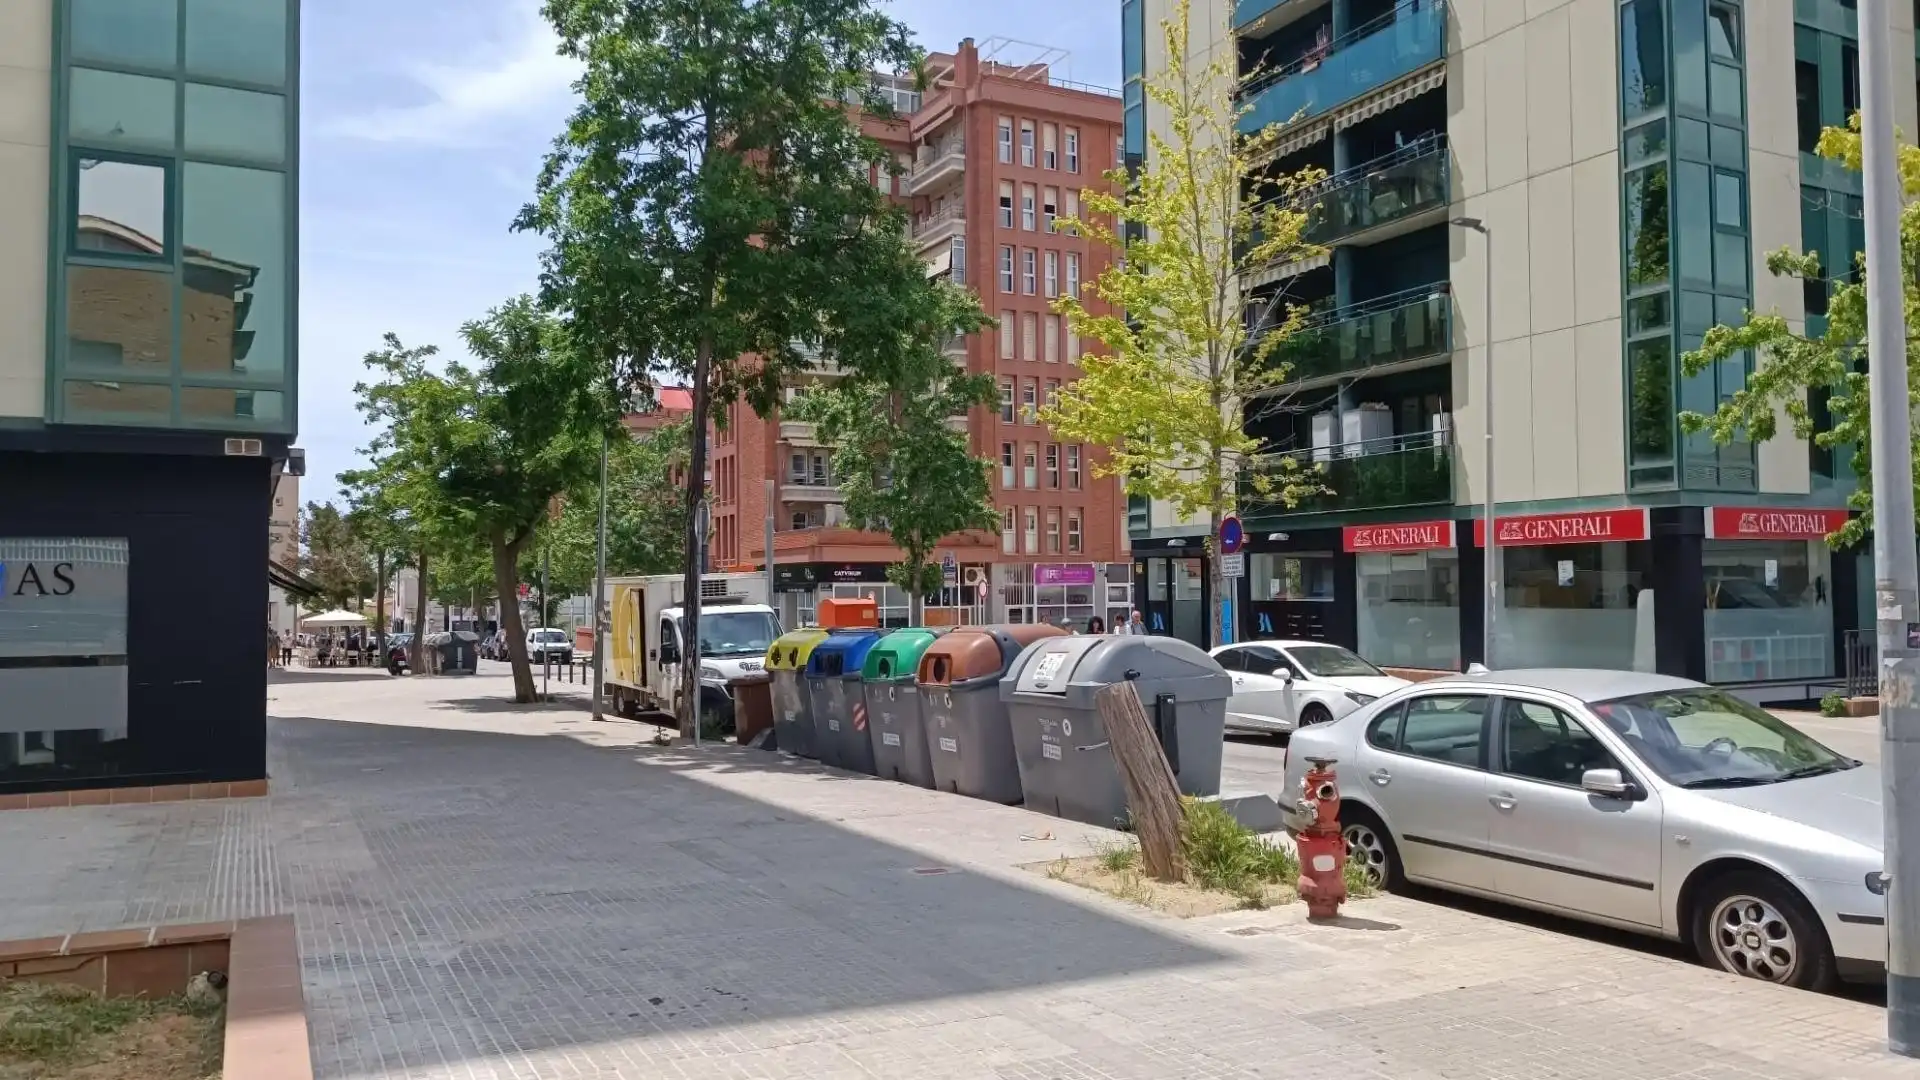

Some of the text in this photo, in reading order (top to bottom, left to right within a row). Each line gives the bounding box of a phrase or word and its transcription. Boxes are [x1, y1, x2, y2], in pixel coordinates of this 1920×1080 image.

[1524, 516, 1612, 539] GENERALI
[1760, 513, 1826, 533] GENERALI
[1372, 526, 1440, 546] GENERALI
[12, 562, 76, 596] AS
